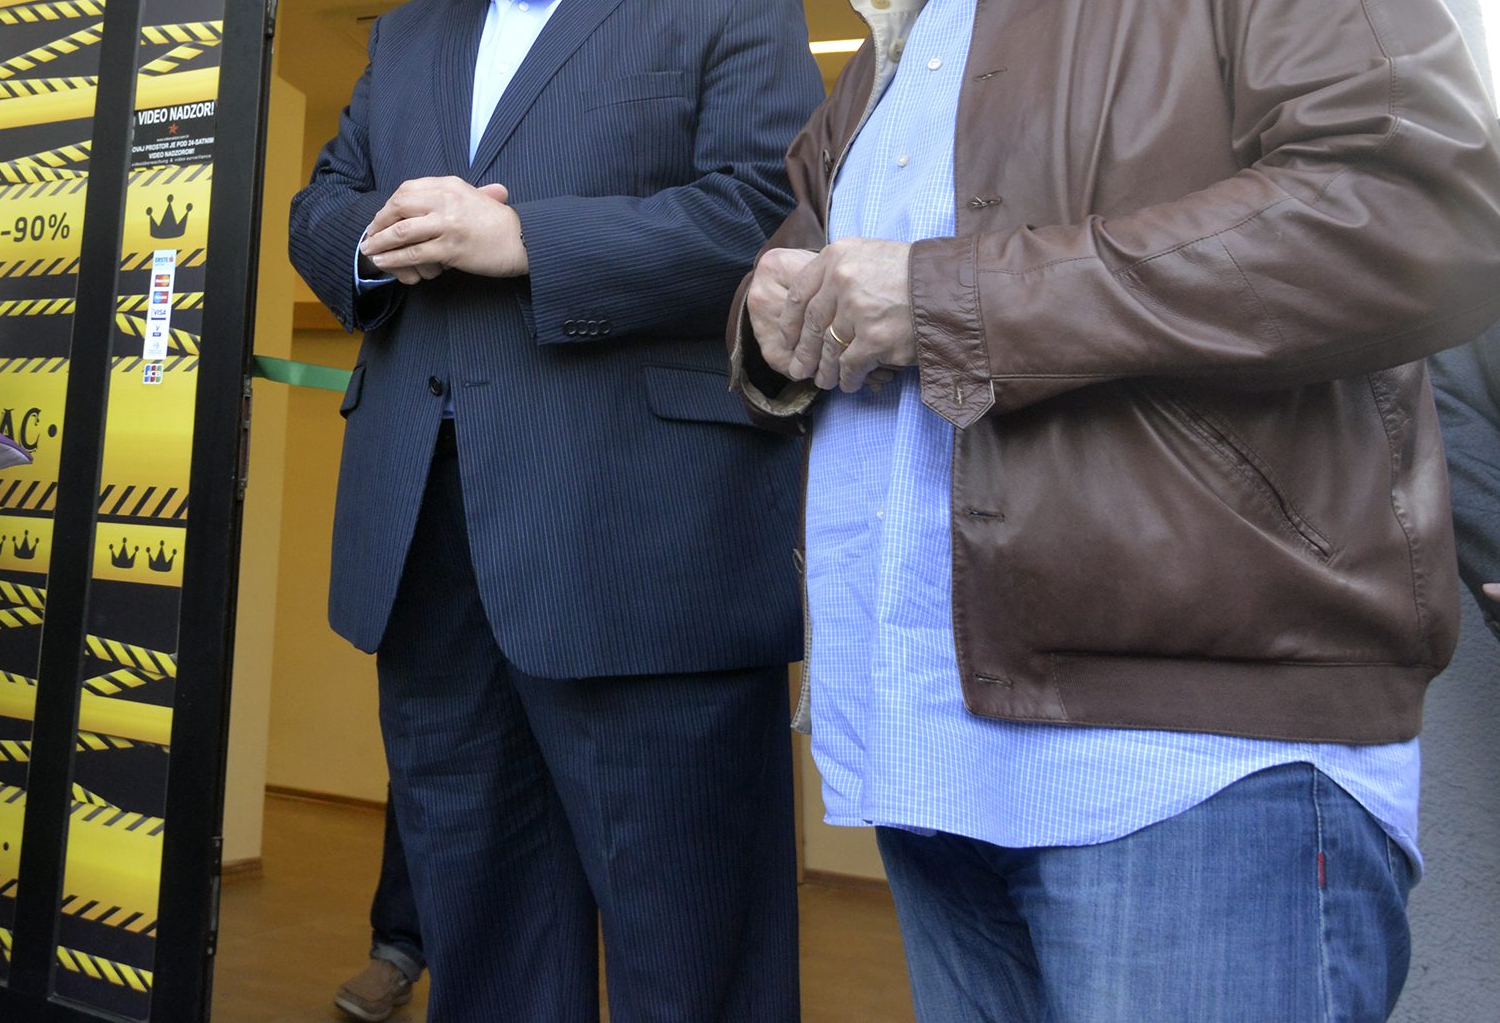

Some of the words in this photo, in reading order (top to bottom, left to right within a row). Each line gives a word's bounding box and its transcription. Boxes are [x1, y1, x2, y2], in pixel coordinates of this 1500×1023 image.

[138, 108, 168, 125] VIDEO
[169, 101, 215, 121] NADZOR!
[145, 142, 170, 151] PROSTOR
[176, 139, 188, 148] POD
[148, 151, 165, 159] VIDEO
[0, 211, 70, 243] -90%
